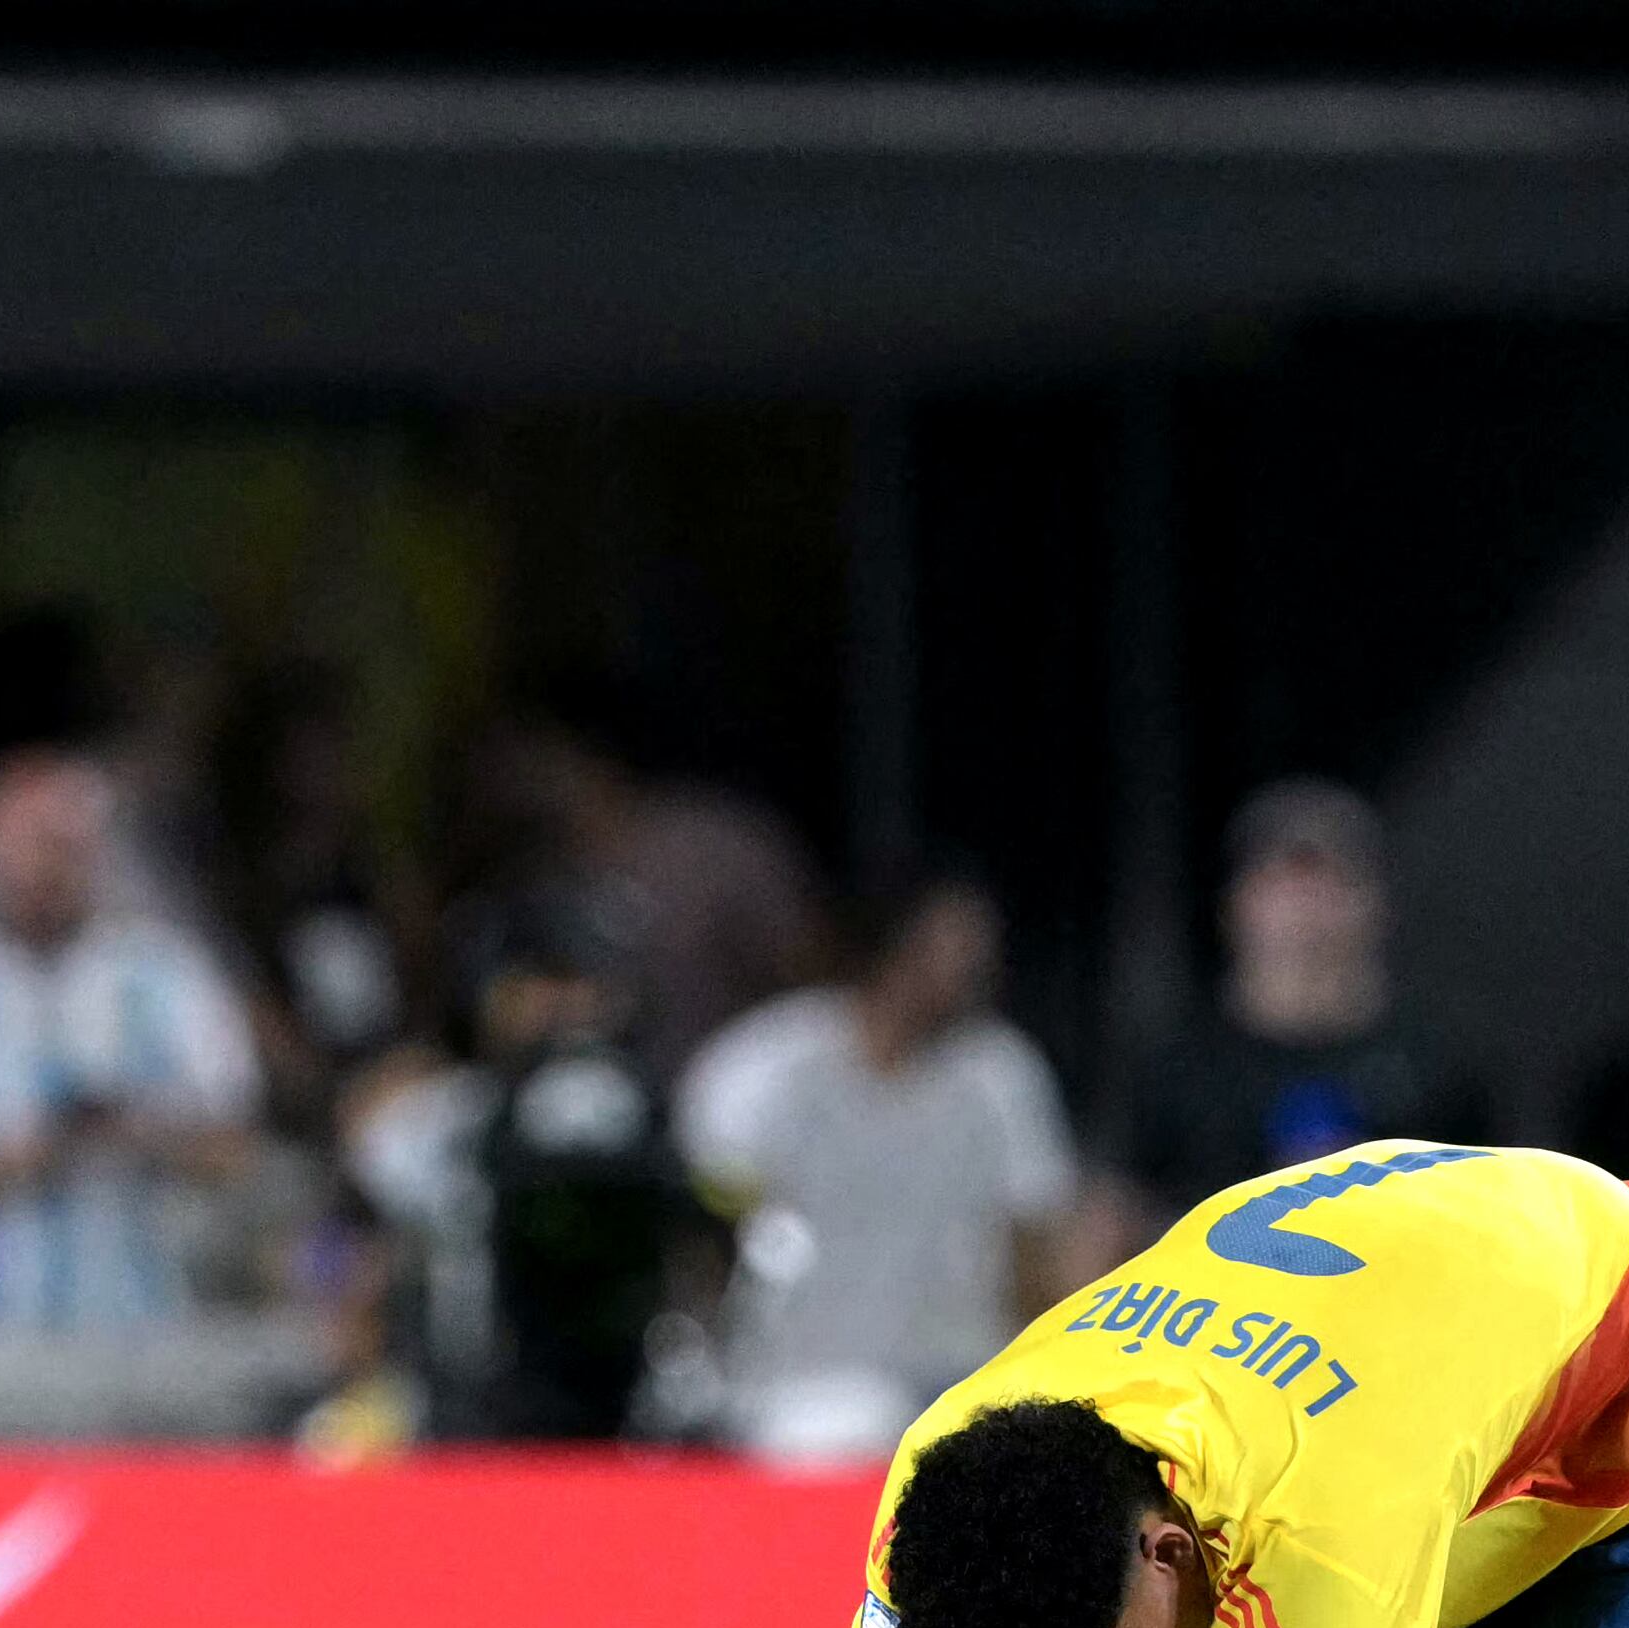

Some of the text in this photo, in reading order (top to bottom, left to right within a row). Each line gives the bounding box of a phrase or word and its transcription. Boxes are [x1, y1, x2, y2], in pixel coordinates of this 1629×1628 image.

[1206, 1149, 1499, 1276] 7
[1065, 1282, 1358, 1417] LUIS DÍAZ
